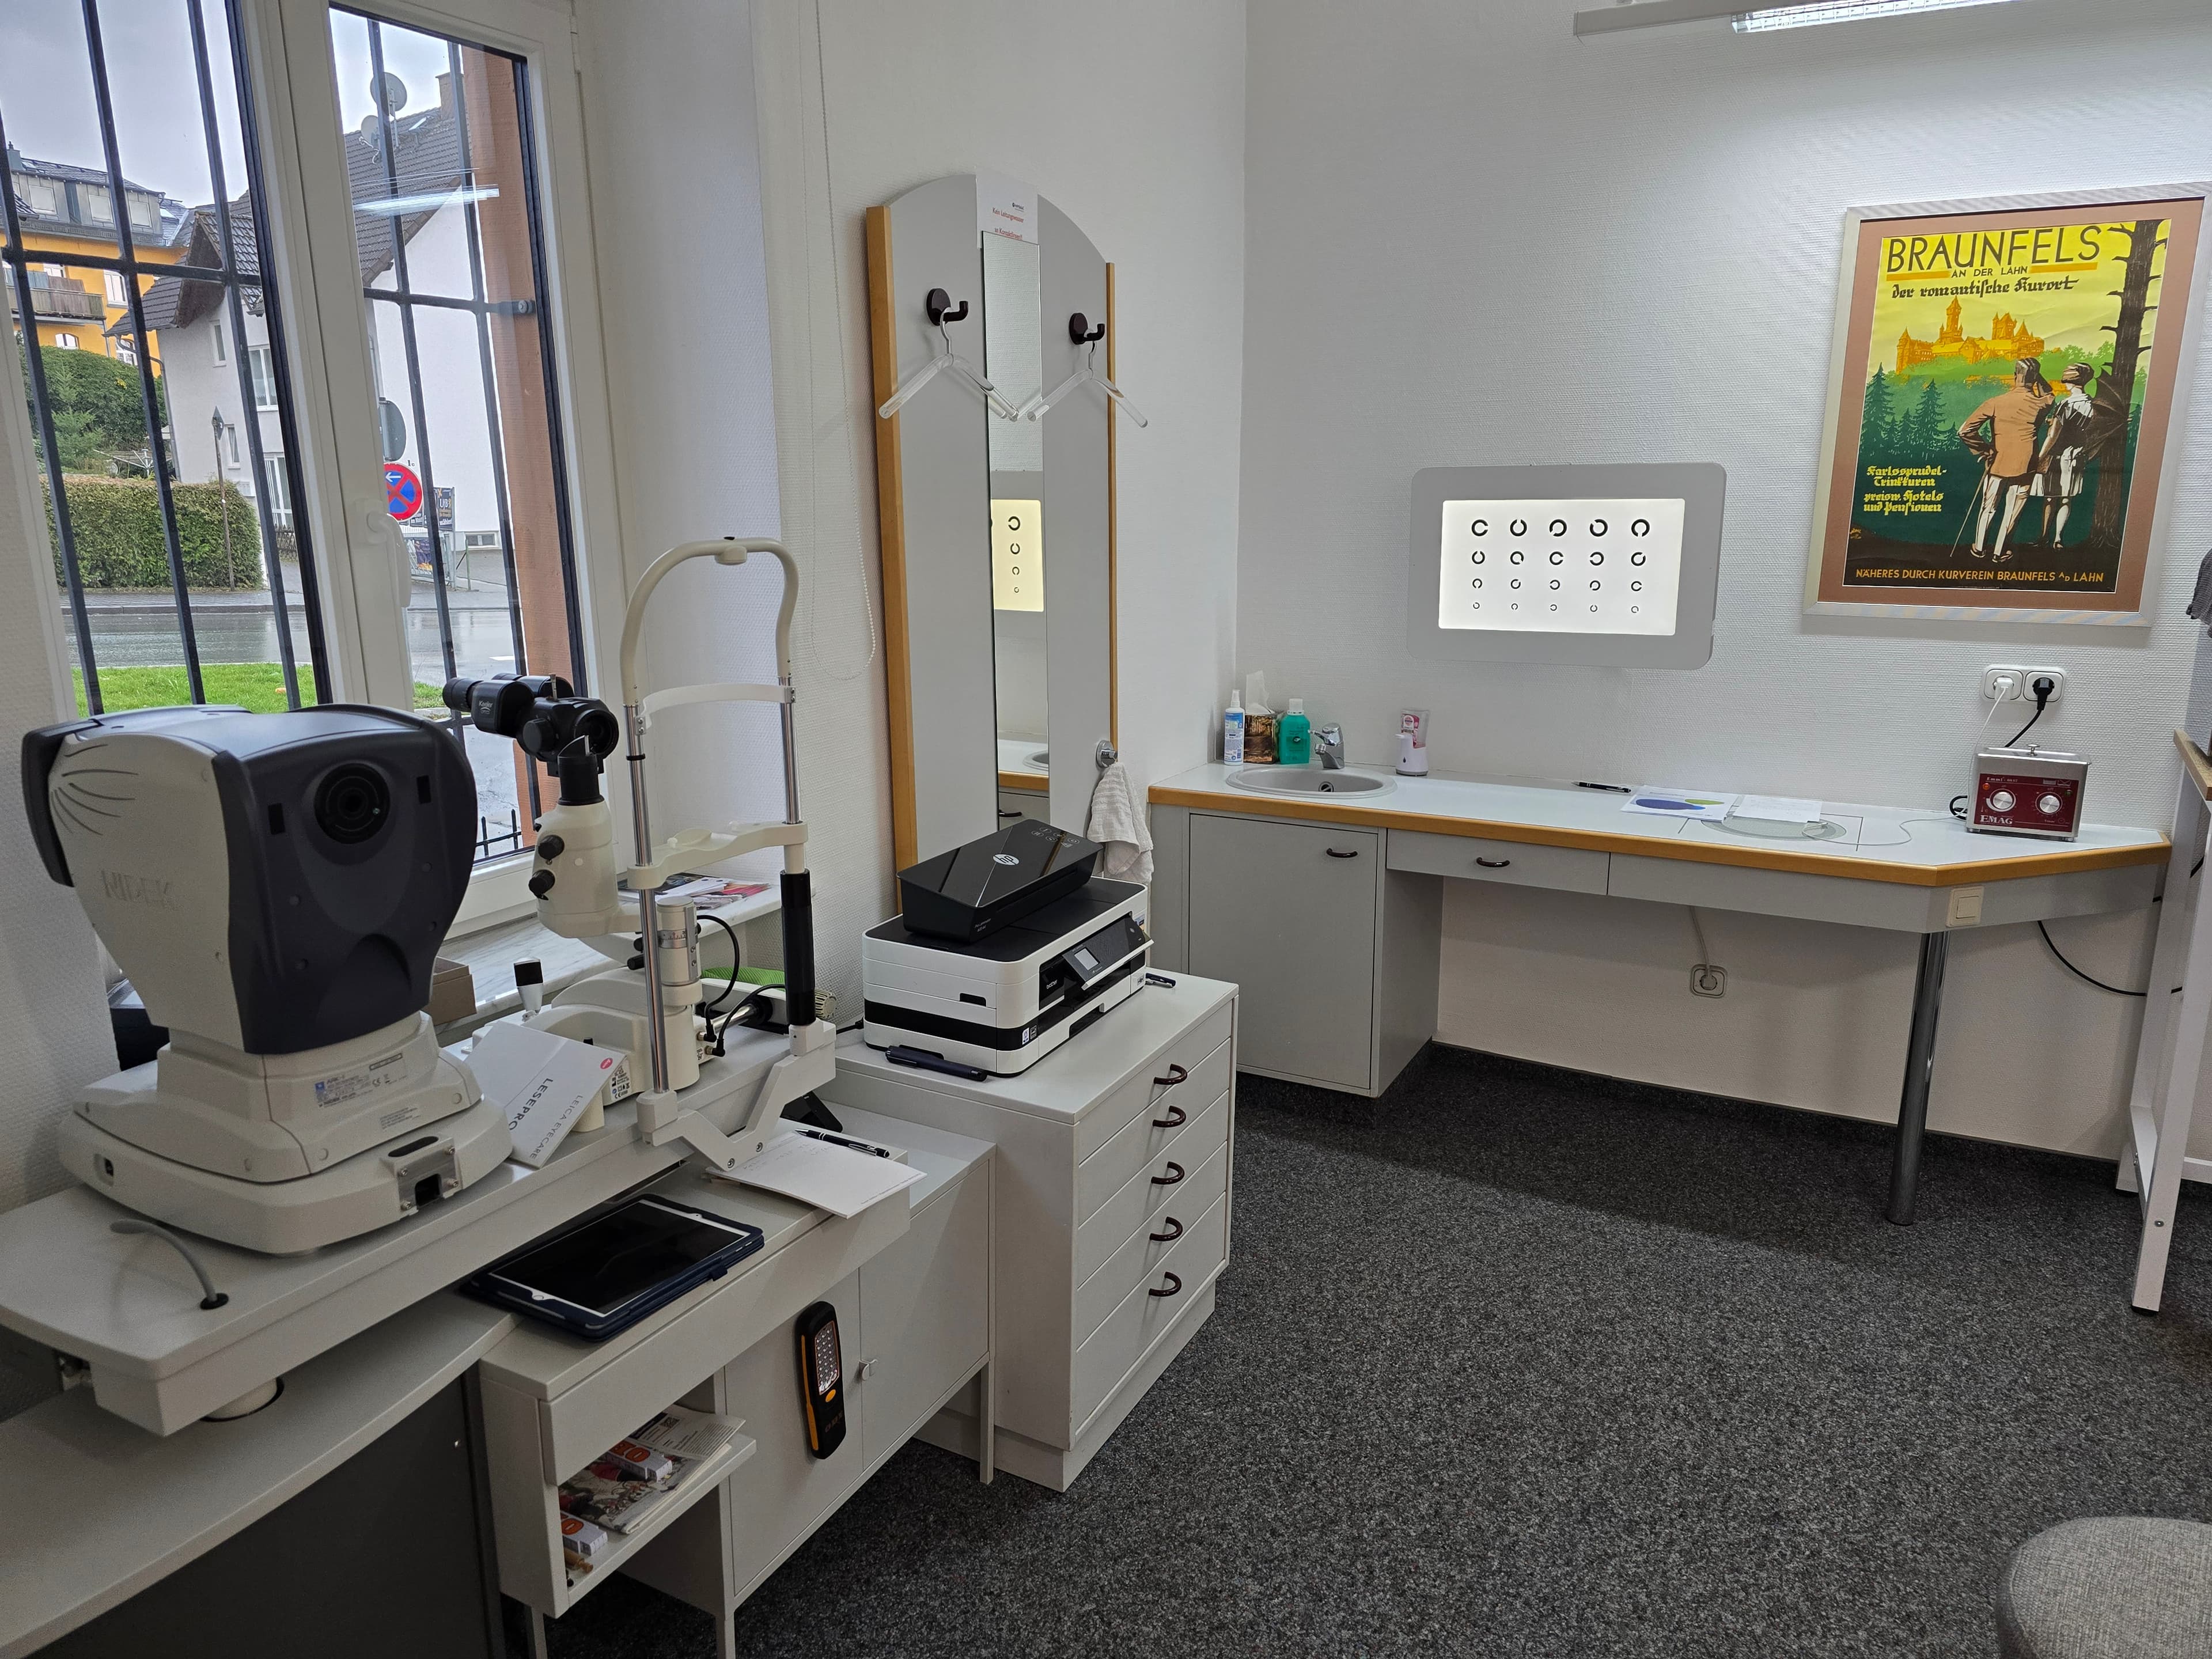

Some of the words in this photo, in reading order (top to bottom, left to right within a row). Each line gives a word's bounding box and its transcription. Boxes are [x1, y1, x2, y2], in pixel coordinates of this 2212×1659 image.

[1887, 225, 2101, 272] BRAUNFELS
[1951, 269, 1966, 278] AN
[1974, 268, 1993, 276] DER
[2001, 266, 2028, 275] LAHN
[1892, 283, 1915, 298] der
[2014, 274, 2080, 293] Kurort
[1903, 489, 1944, 503] Hotels
[1863, 502, 1883, 512] und
[1856, 568, 1900, 579] NÄHERES
[1902, 569, 1936, 579] DURCH
[1938, 570, 1994, 581] KURVEREIN
[1997, 571, 2055, 582] BRAUNFELS
[2073, 572, 2104, 582] LAHN
[1980, 815, 2013, 824] EMAG
[559, 1094, 584, 1120] LEICA
[529, 1122, 562, 1160] EYECARE
